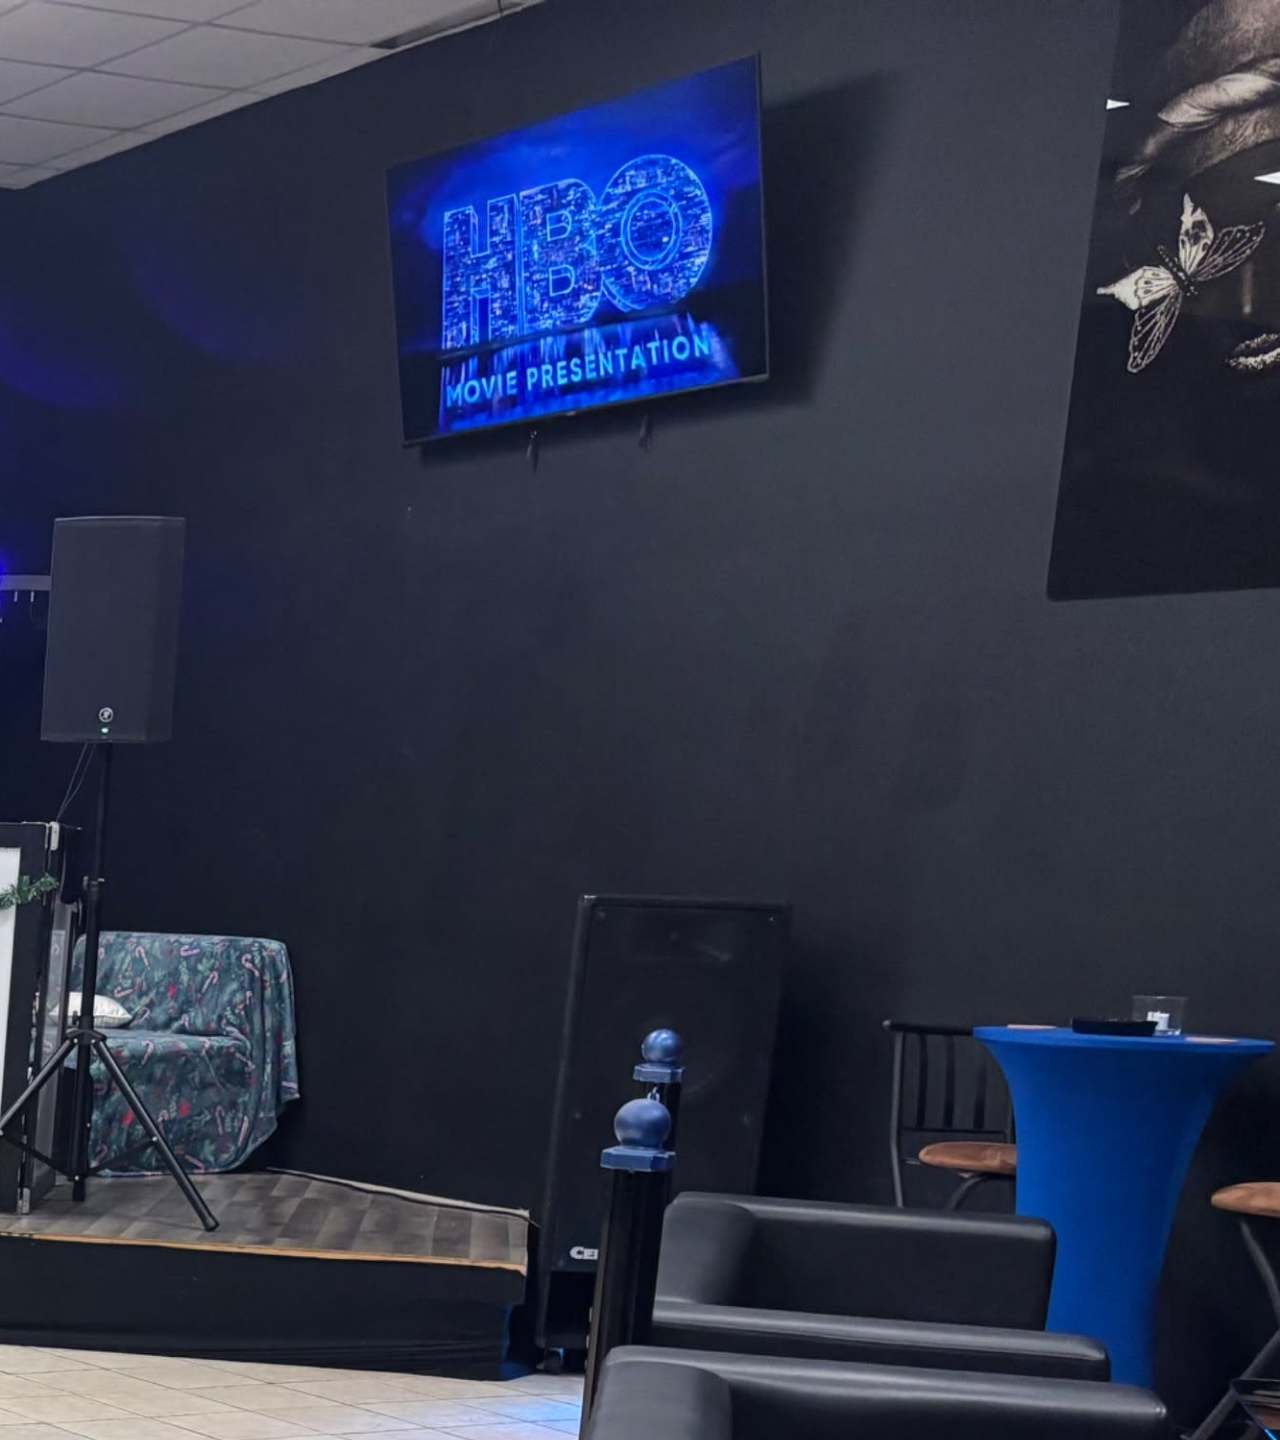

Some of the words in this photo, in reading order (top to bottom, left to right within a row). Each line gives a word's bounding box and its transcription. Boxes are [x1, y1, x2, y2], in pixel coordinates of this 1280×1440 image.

[442, 154, 712, 349] HBO
[446, 371, 517, 407] MOVIE
[527, 334, 709, 391] PRESENTATION
